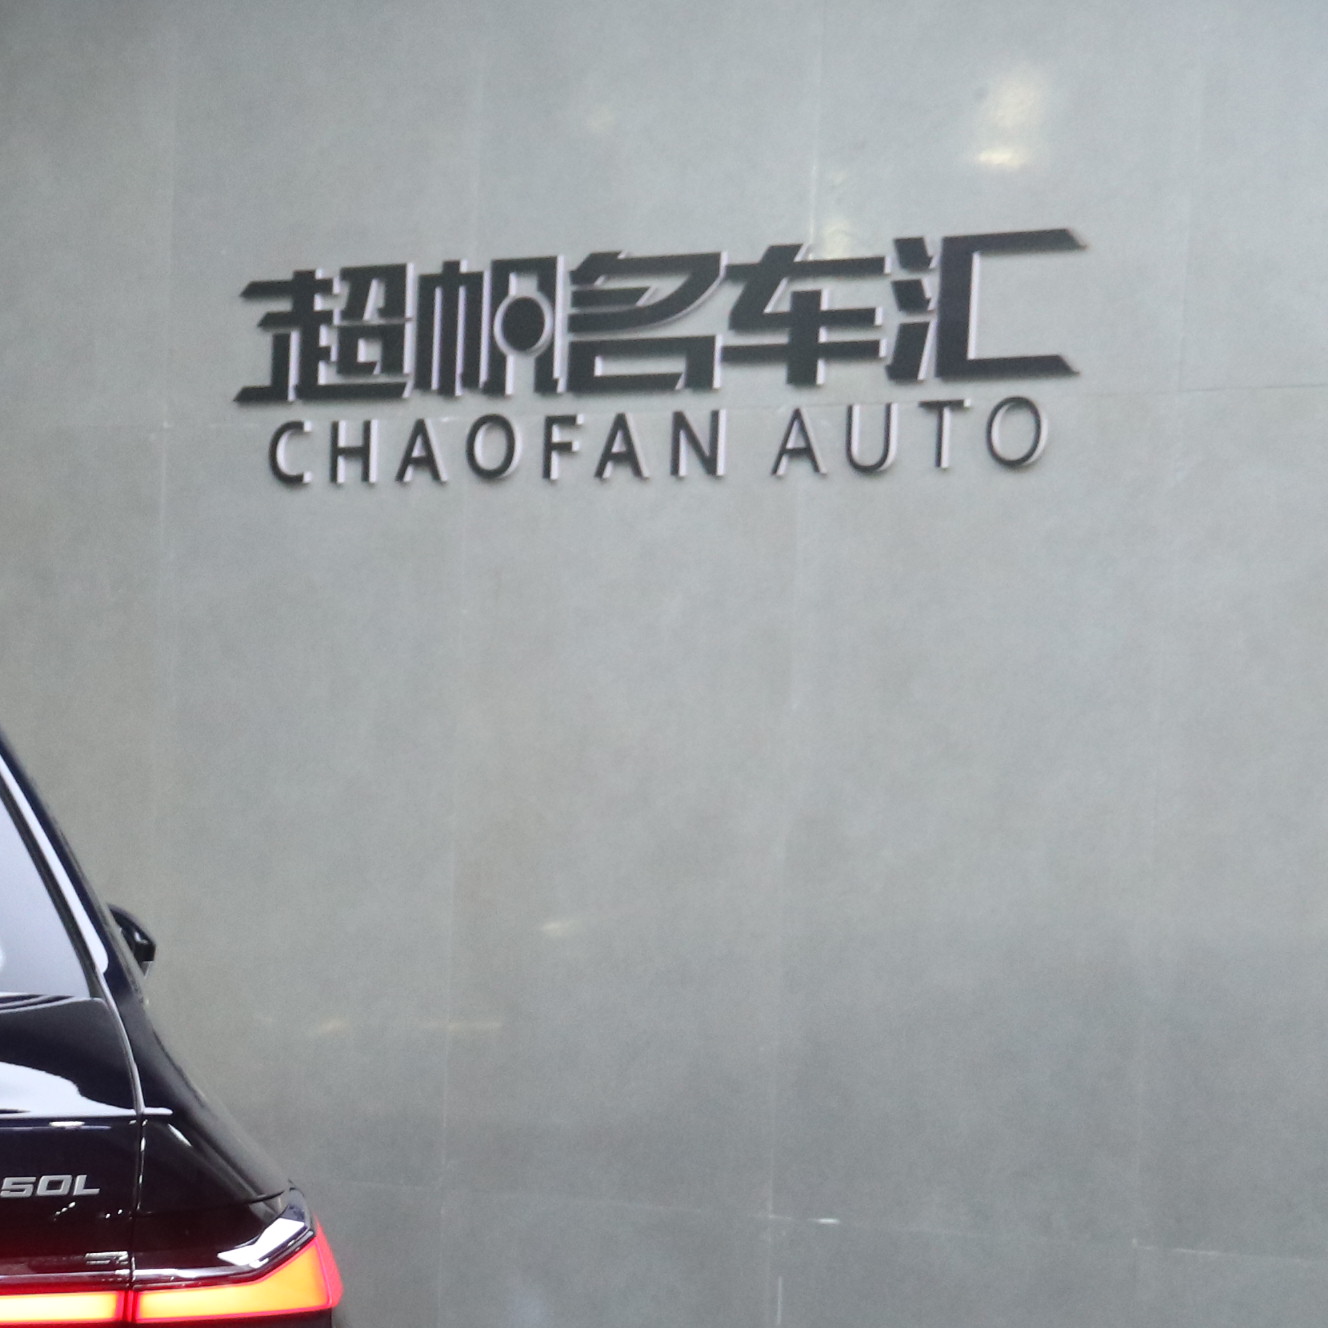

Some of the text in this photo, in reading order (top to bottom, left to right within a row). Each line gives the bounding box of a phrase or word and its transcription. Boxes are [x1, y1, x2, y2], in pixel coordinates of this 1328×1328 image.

[233, 228, 1090, 403] 超帆名车汇
[267, 394, 1050, 485] CHAOFAN AUTO
